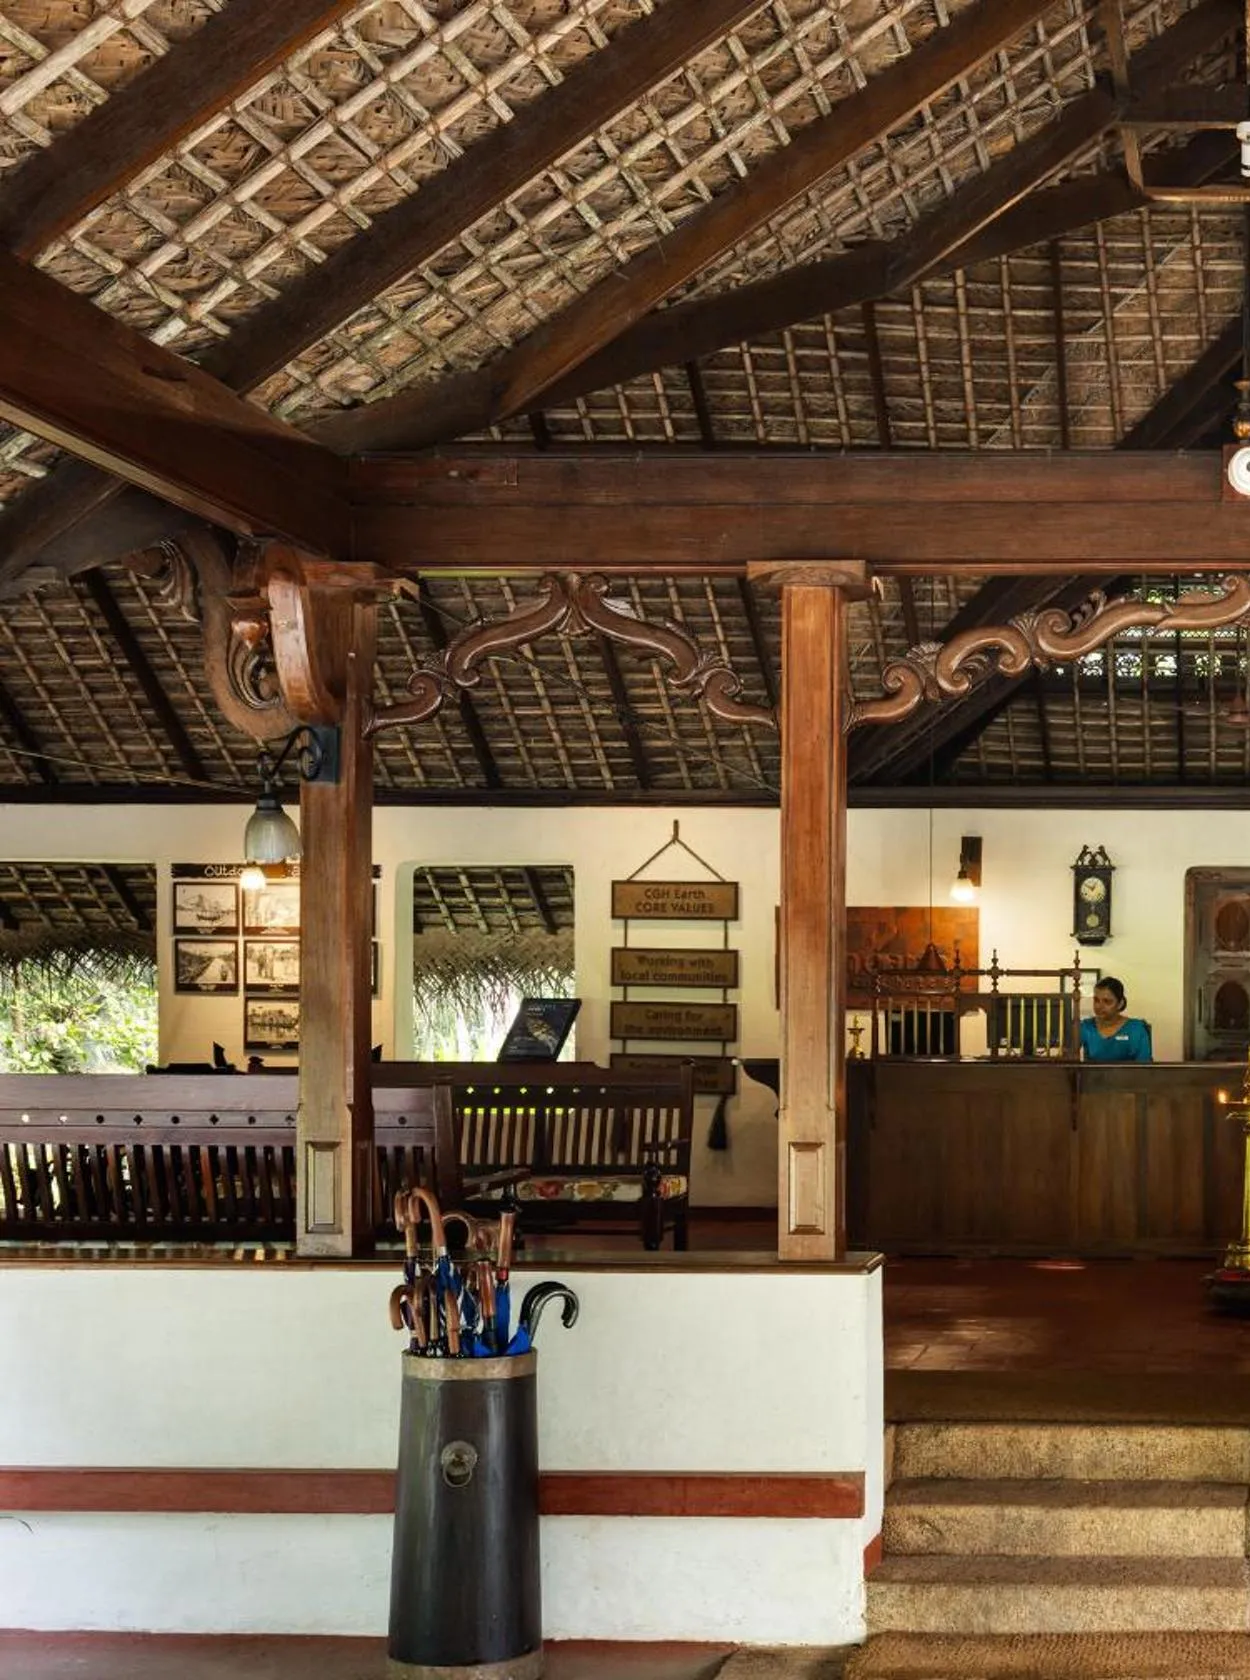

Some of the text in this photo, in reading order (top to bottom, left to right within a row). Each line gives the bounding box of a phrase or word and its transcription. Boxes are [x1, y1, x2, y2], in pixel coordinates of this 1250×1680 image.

[644, 887, 706, 900] CGH Earth
[635, 902, 715, 914] CORE VALUES
[620, 970, 728, 983] local communities
